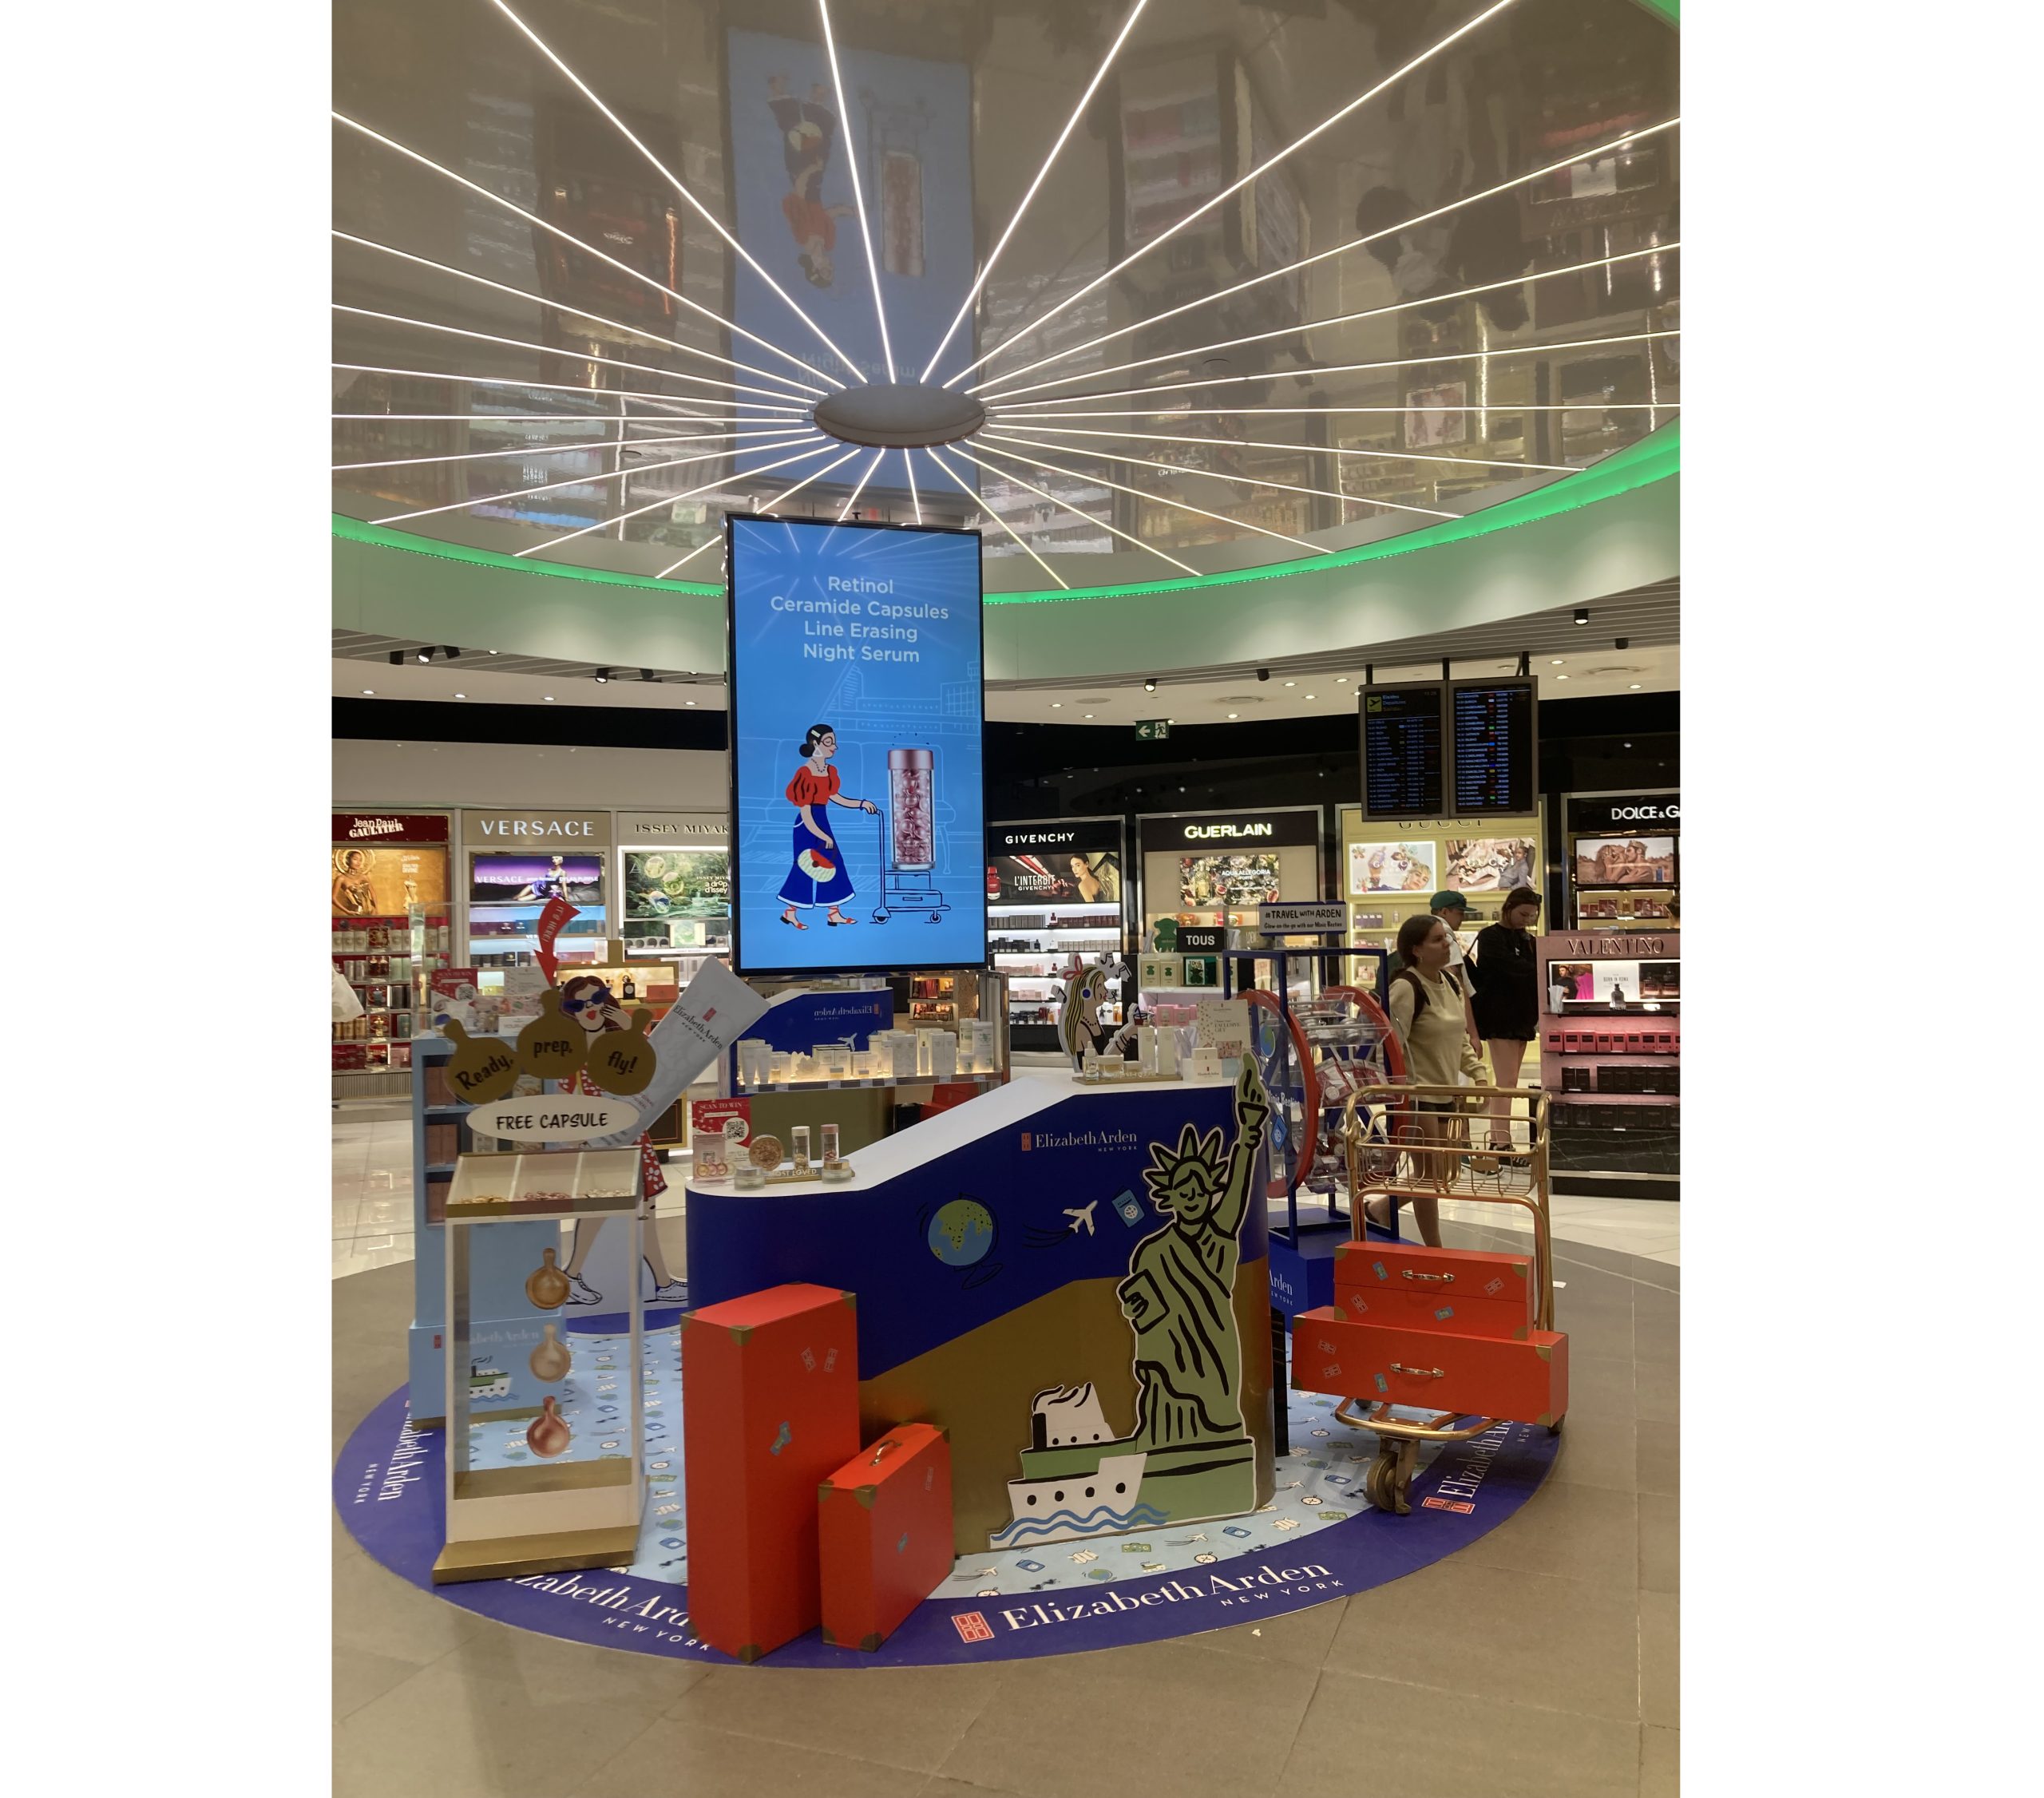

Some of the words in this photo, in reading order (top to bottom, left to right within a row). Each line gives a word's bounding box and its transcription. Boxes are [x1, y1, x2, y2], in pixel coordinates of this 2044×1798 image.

[828, 576, 893, 595] Retinol
[770, 596, 862, 616] Ceramide
[867, 601, 949, 620] Capsules
[804, 620, 846, 638] Line
[850, 623, 918, 643] Erasing
[802, 644, 855, 663] Night
[862, 647, 921, 663] Serum
[349, 822, 404, 838] GAULTIER
[353, 818, 374, 828] Jean
[375, 818, 398, 828] Paul
[481, 820, 594, 836] VERSACE
[636, 824, 678, 834] ISSEY
[683, 825, 728, 834] MIYAK
[1184, 823, 1273, 838] GUERLAIN
[1005, 833, 1075, 844] GIVENCHY
[1015, 875, 1056, 886] L'INTERDIT
[1265, 909, 1298, 919] #TRAVEL
[1316, 909, 1341, 918] ARDEN
[1186, 935, 1215, 945] TOUS
[1568, 937, 1664, 956] VALENTINO
[673, 1004, 704, 1033] Elizabeth
[704, 1029, 723, 1049] Arden
[533, 1040, 573, 1058] prep.
[608, 1051, 638, 1075] fly!
[456, 1055, 514, 1091] Ready.
[497, 1115, 533, 1130] FREE
[540, 1112, 608, 1129] CAPSULE
[1036, 1131, 1096, 1148] Elizabeth
[1098, 1129, 1137, 1144] Arden
[1437, 1440, 1502, 1499] Elizabeth
[378, 1461, 425, 1501] Arden
[998, 1580, 1205, 1631] Elizabeth
[1210, 1560, 1333, 1595] Arden
[1221, 1591, 1270, 1607] NEW
[1280, 1578, 1345, 1596] YORK
[603, 1616, 649, 1633] NEW
[656, 1630, 711, 1651] YORK
